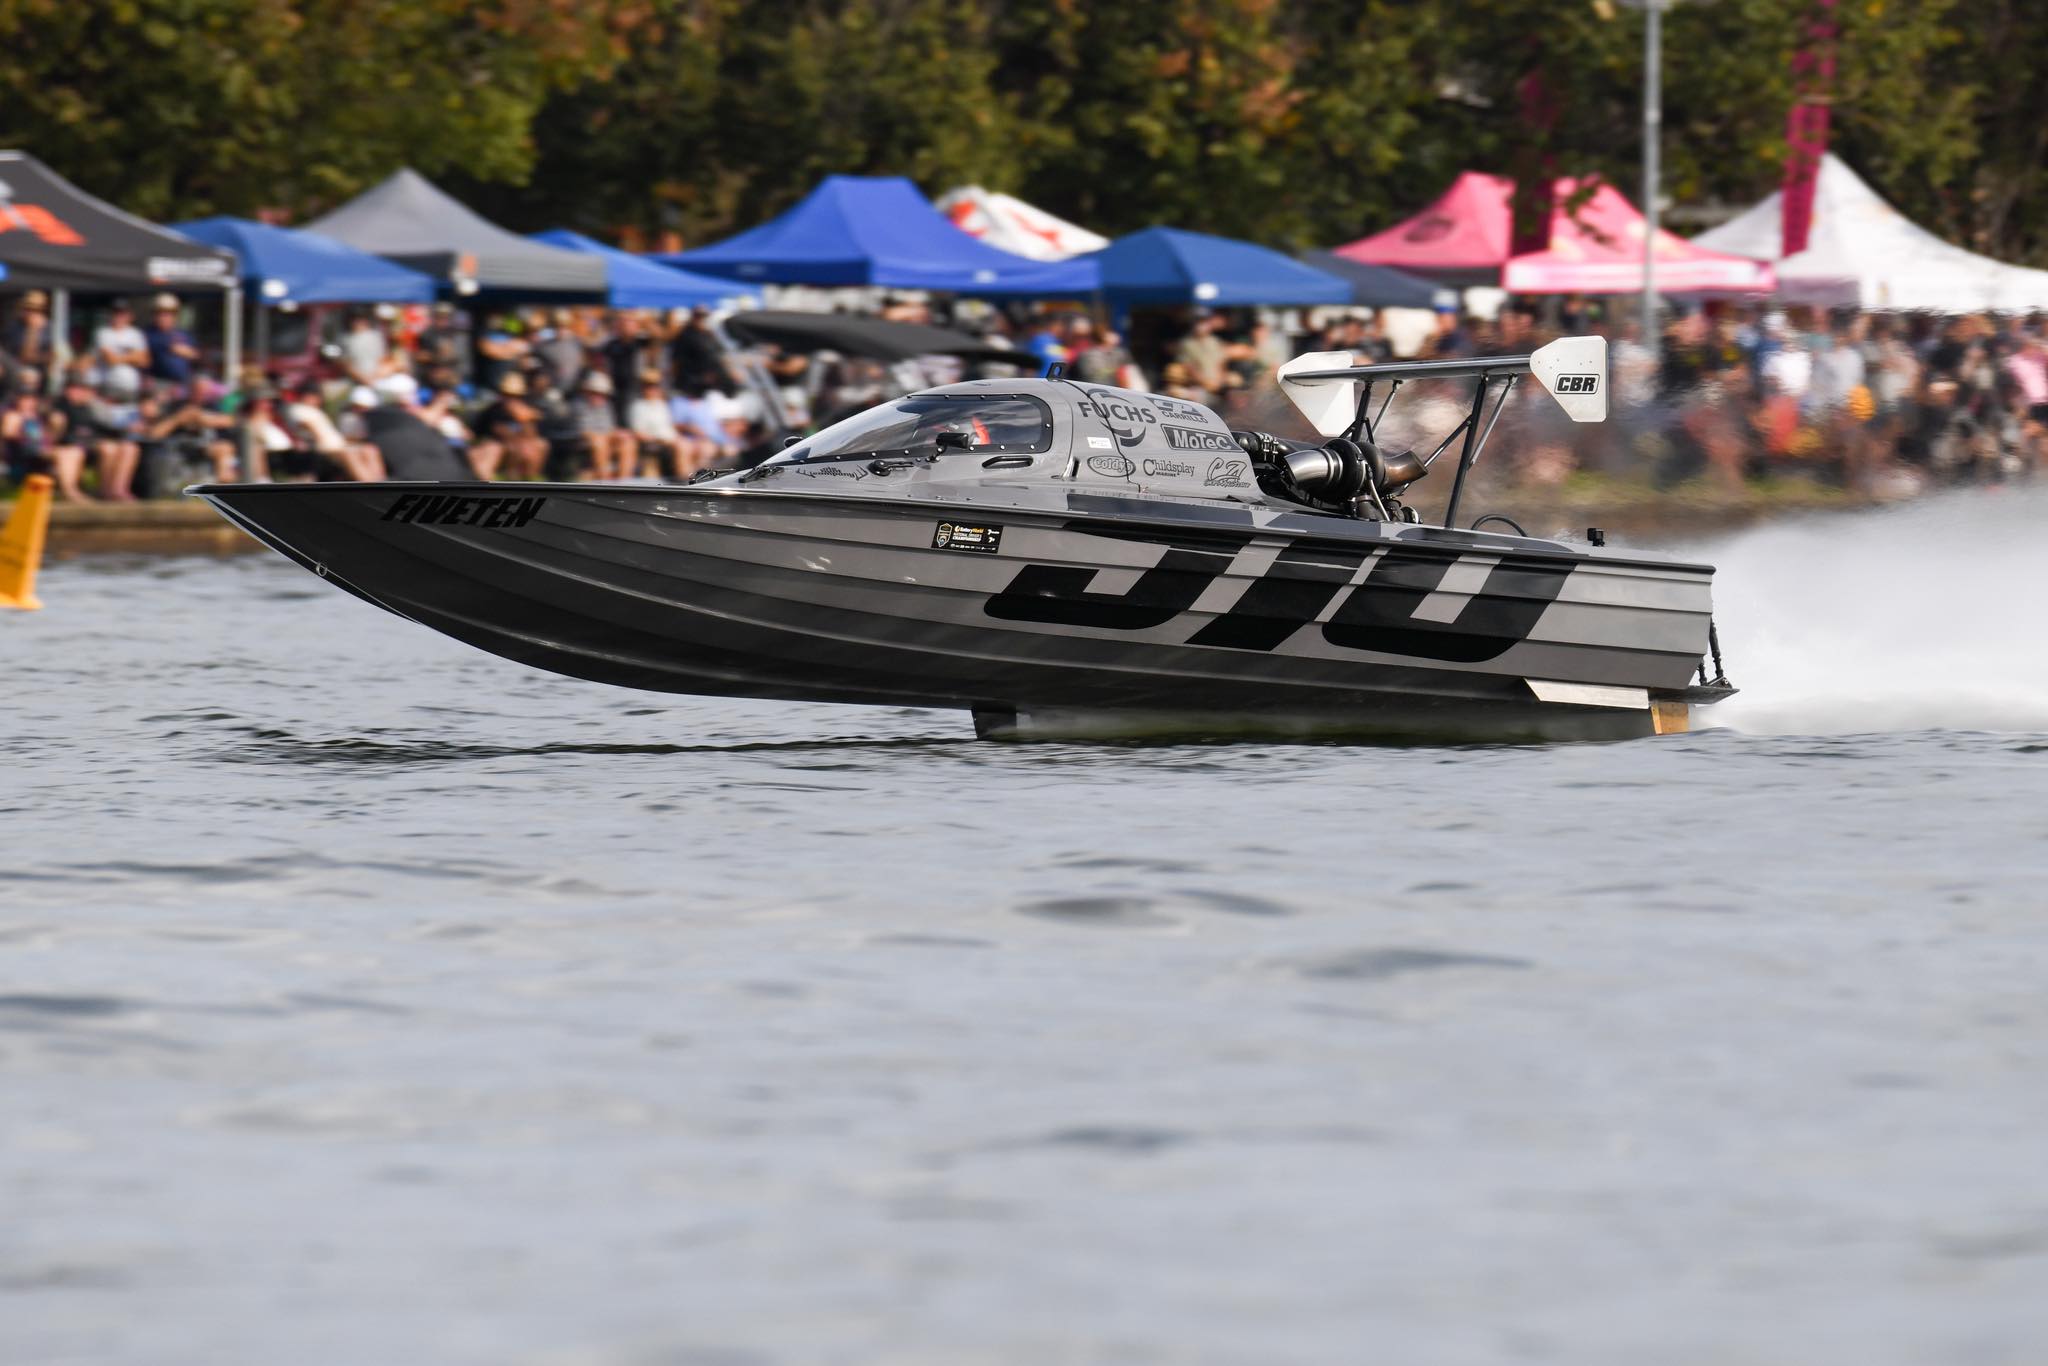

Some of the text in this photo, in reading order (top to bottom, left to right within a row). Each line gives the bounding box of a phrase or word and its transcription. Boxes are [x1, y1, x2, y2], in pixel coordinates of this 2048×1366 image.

[1557, 377, 1596, 391] CBR
[1077, 401, 1157, 424] FUCHS
[1161, 410, 1209, 424] CARRILLO
[1173, 429, 1232, 450] MoTeC
[1142, 458, 1195, 478] Childsplay
[380, 494, 547, 528] FIVETEN
